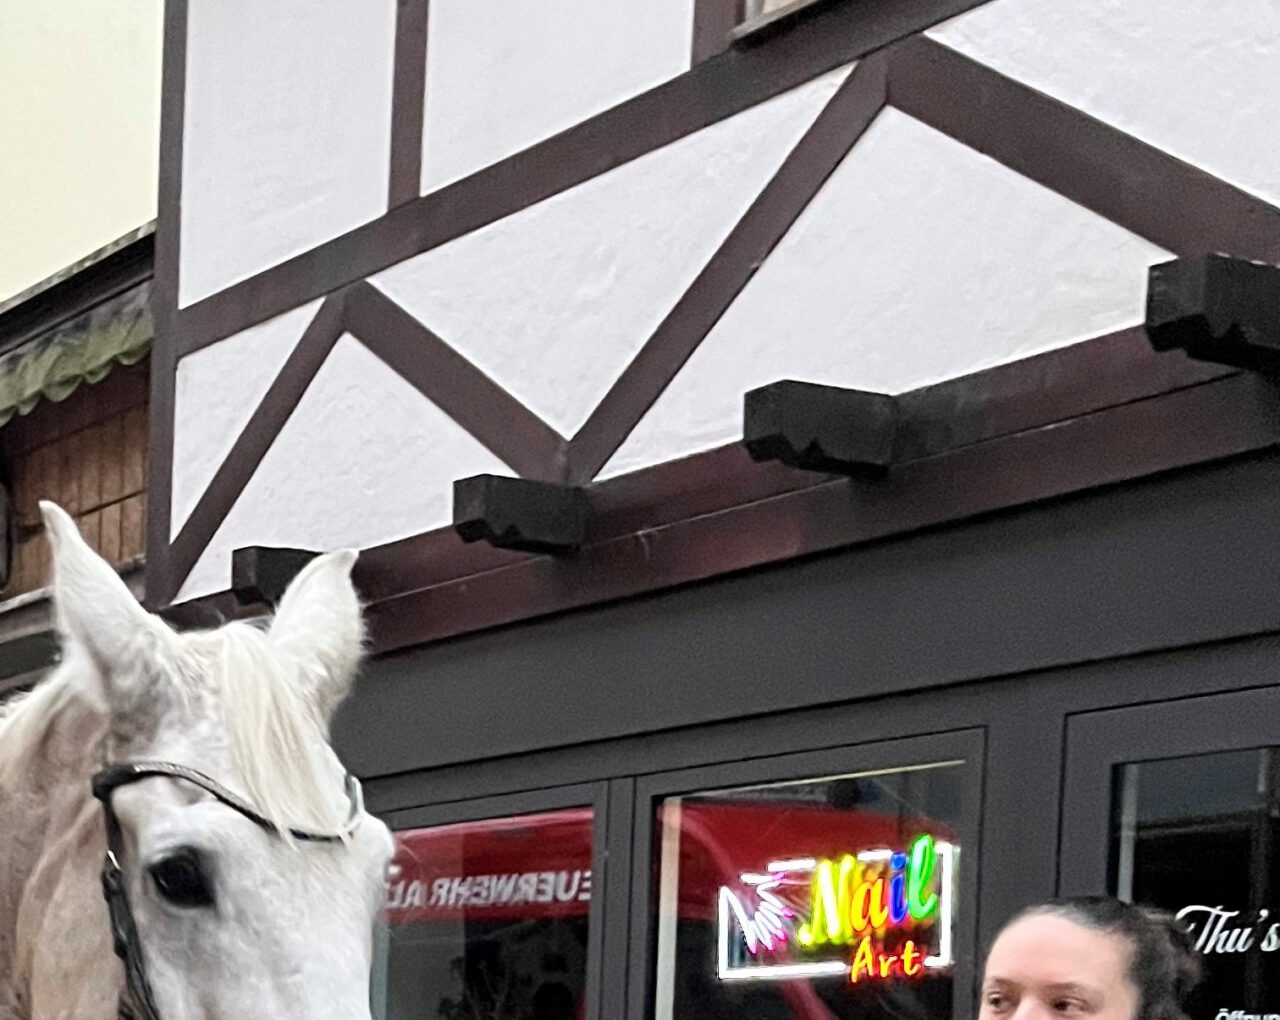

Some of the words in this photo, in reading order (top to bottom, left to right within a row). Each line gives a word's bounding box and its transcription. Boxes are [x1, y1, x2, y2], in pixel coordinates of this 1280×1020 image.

[798, 834, 937, 945] Nail
[1175, 905, 1280, 954] Thu's
[851, 937, 920, 983] Art
